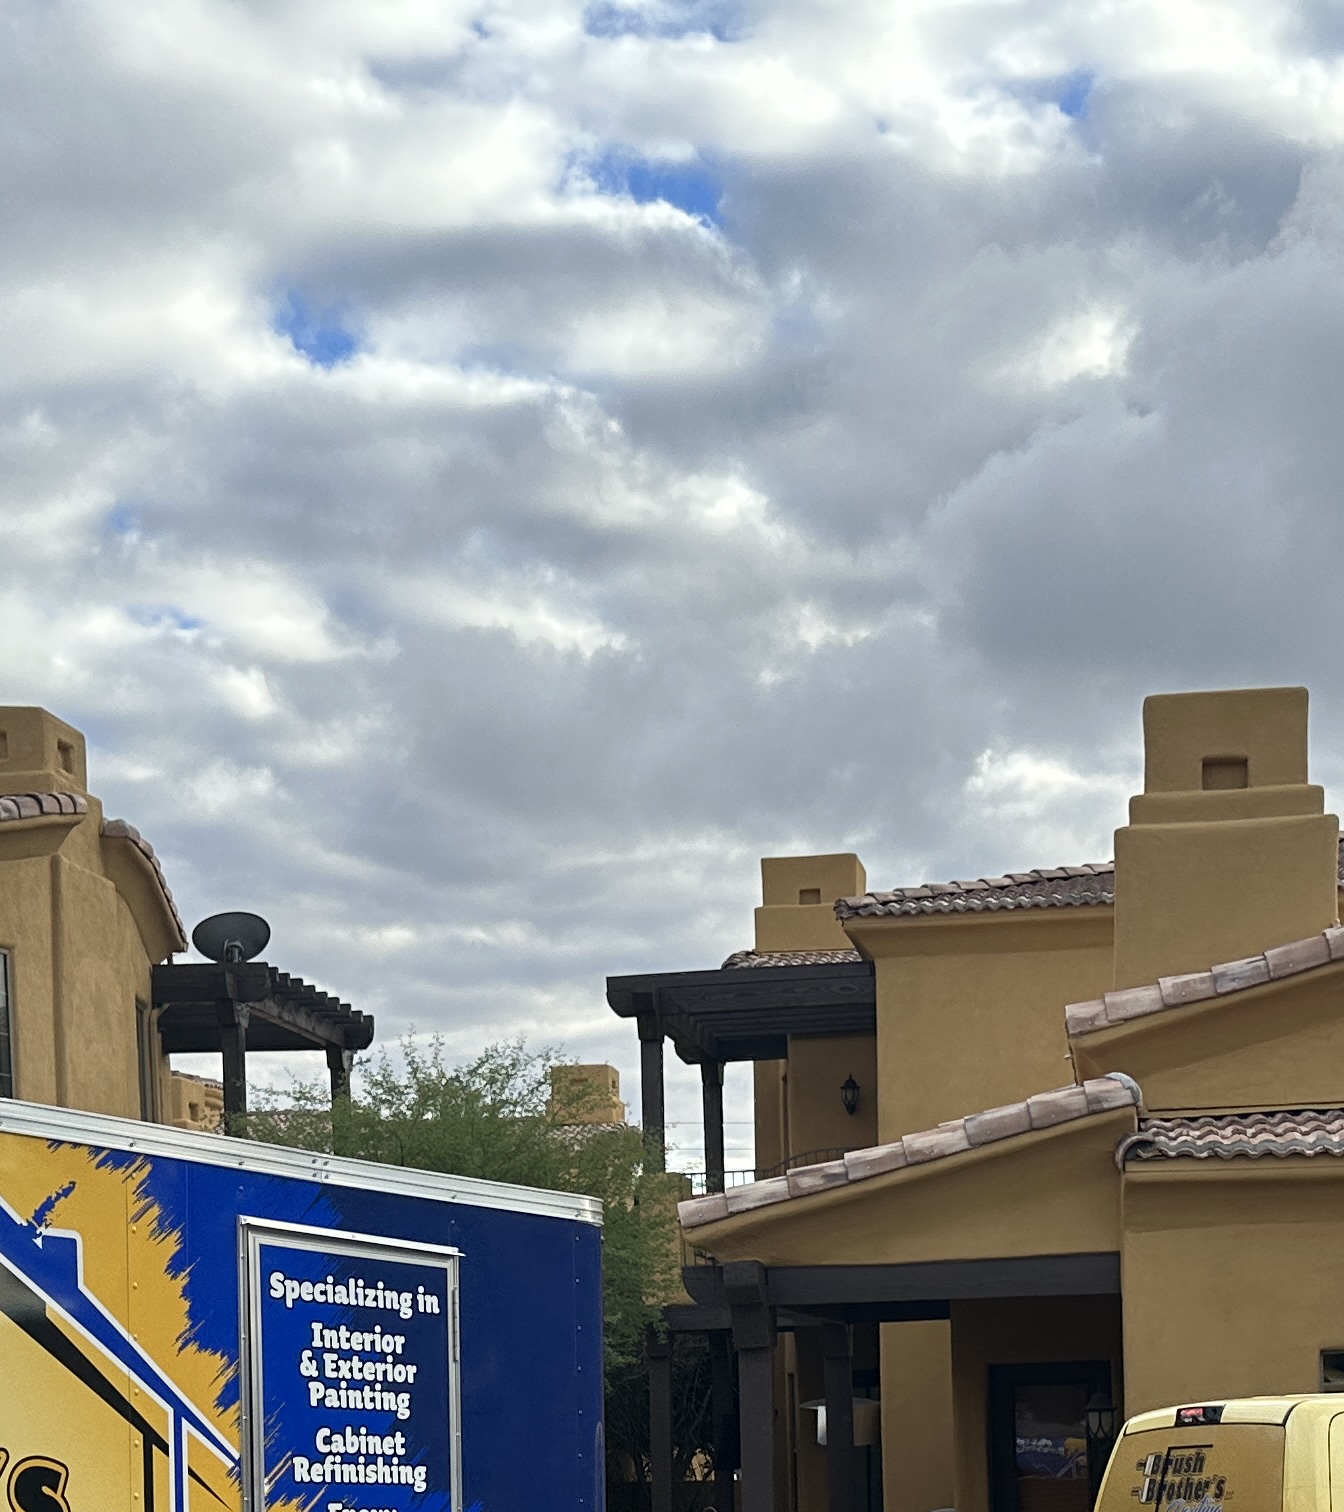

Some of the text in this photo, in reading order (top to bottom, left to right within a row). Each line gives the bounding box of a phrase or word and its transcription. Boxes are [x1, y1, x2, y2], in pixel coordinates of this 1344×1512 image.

[269, 1271, 440, 1320] Specializing in
[311, 1322, 405, 1354] Interior
[299, 1350, 417, 1384] & Exterior
[308, 1380, 411, 1420] Painting
[315, 1426, 406, 1456] Cabinet
[292, 1455, 427, 1493] Refinishing
[1150, 1449, 1207, 1476] Brush
[1145, 1475, 1227, 1504] Brother's
